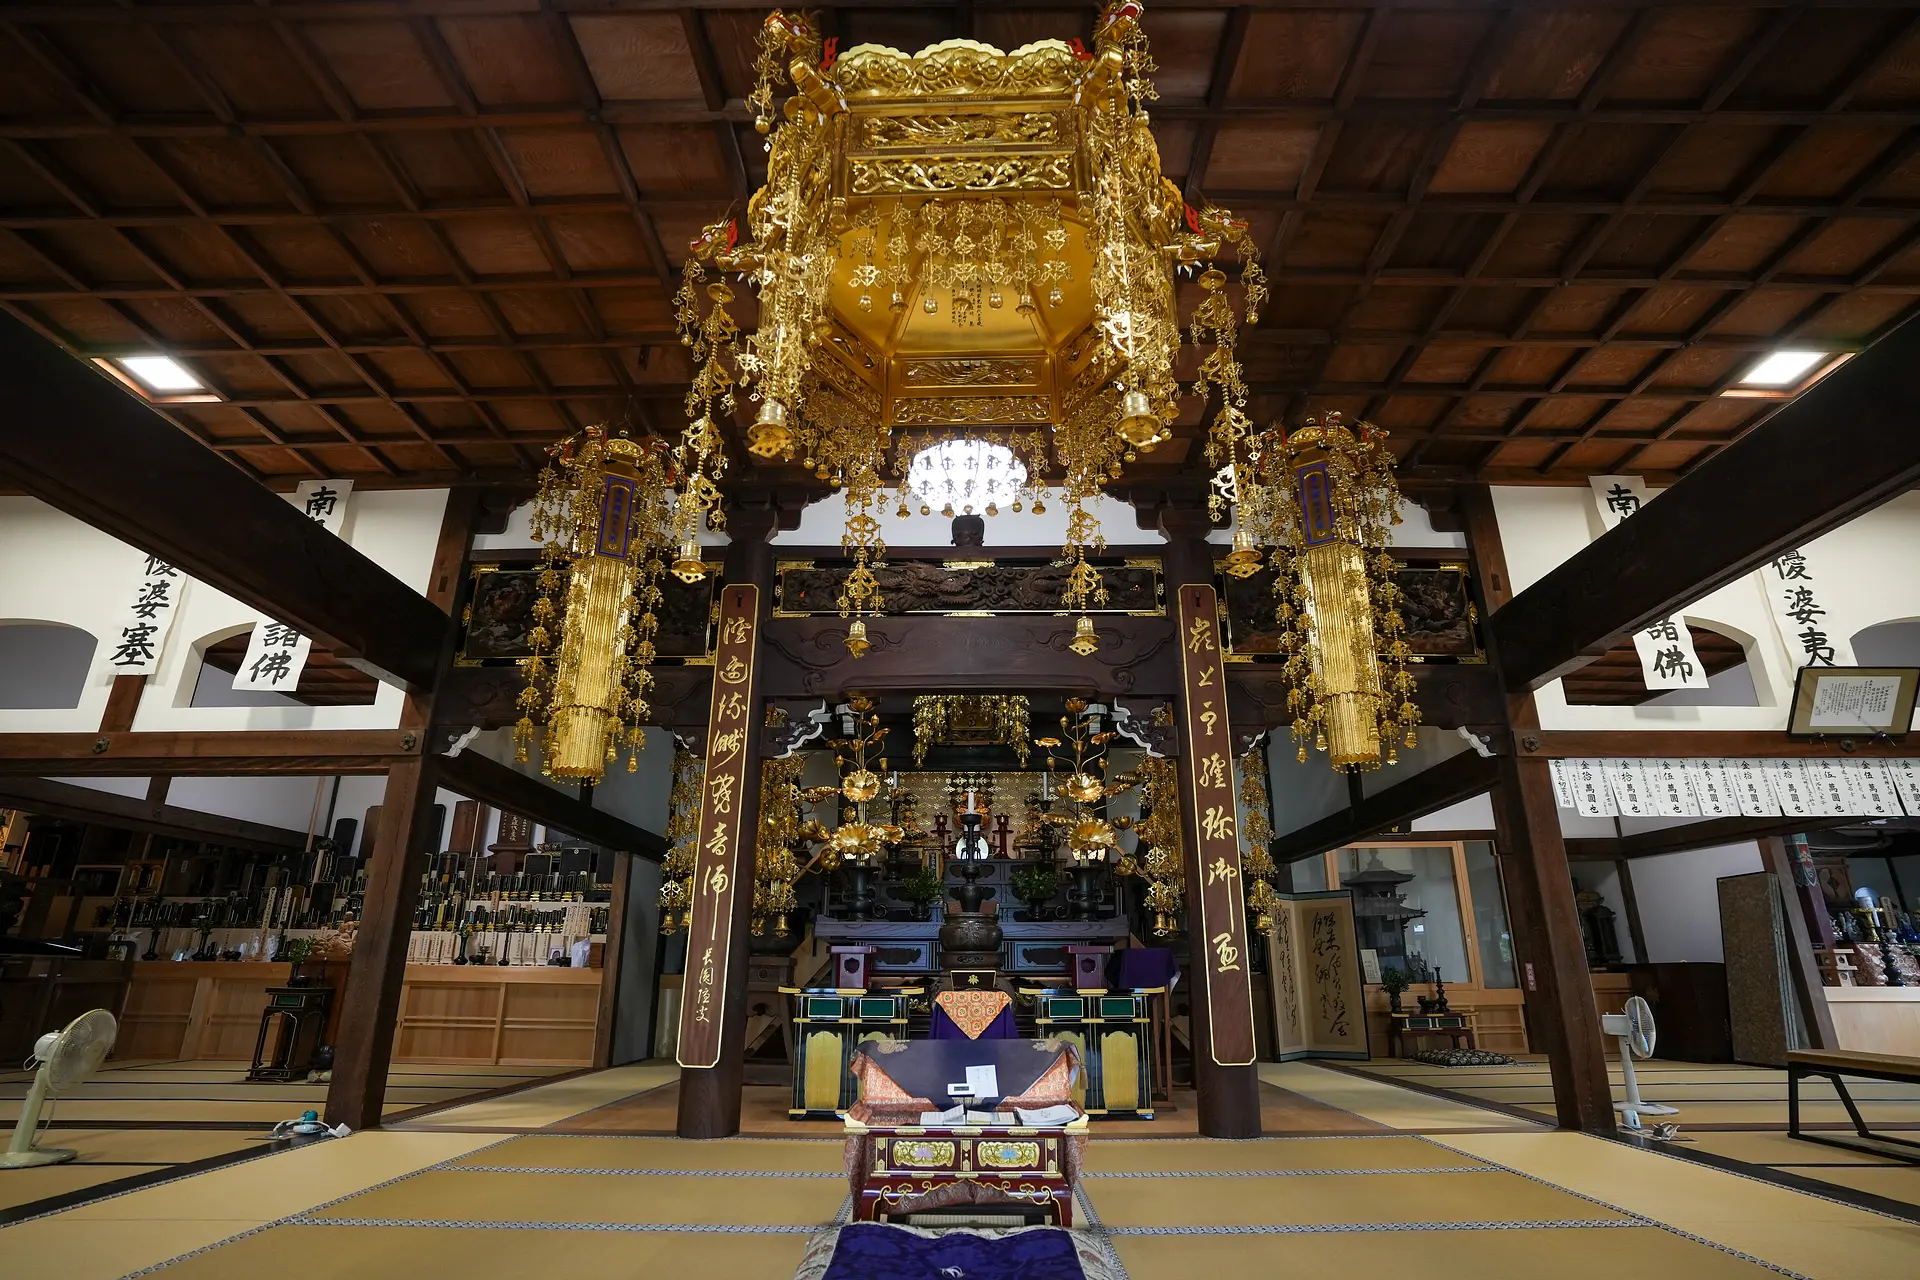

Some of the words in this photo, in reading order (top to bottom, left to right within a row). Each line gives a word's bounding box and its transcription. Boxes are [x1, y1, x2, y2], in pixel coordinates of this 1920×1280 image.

[305, 485, 338, 527] 南
[1606, 483, 1640, 523] 南
[1771, 549, 1836, 667] 優婆夷
[248, 622, 300, 685] 諸佛
